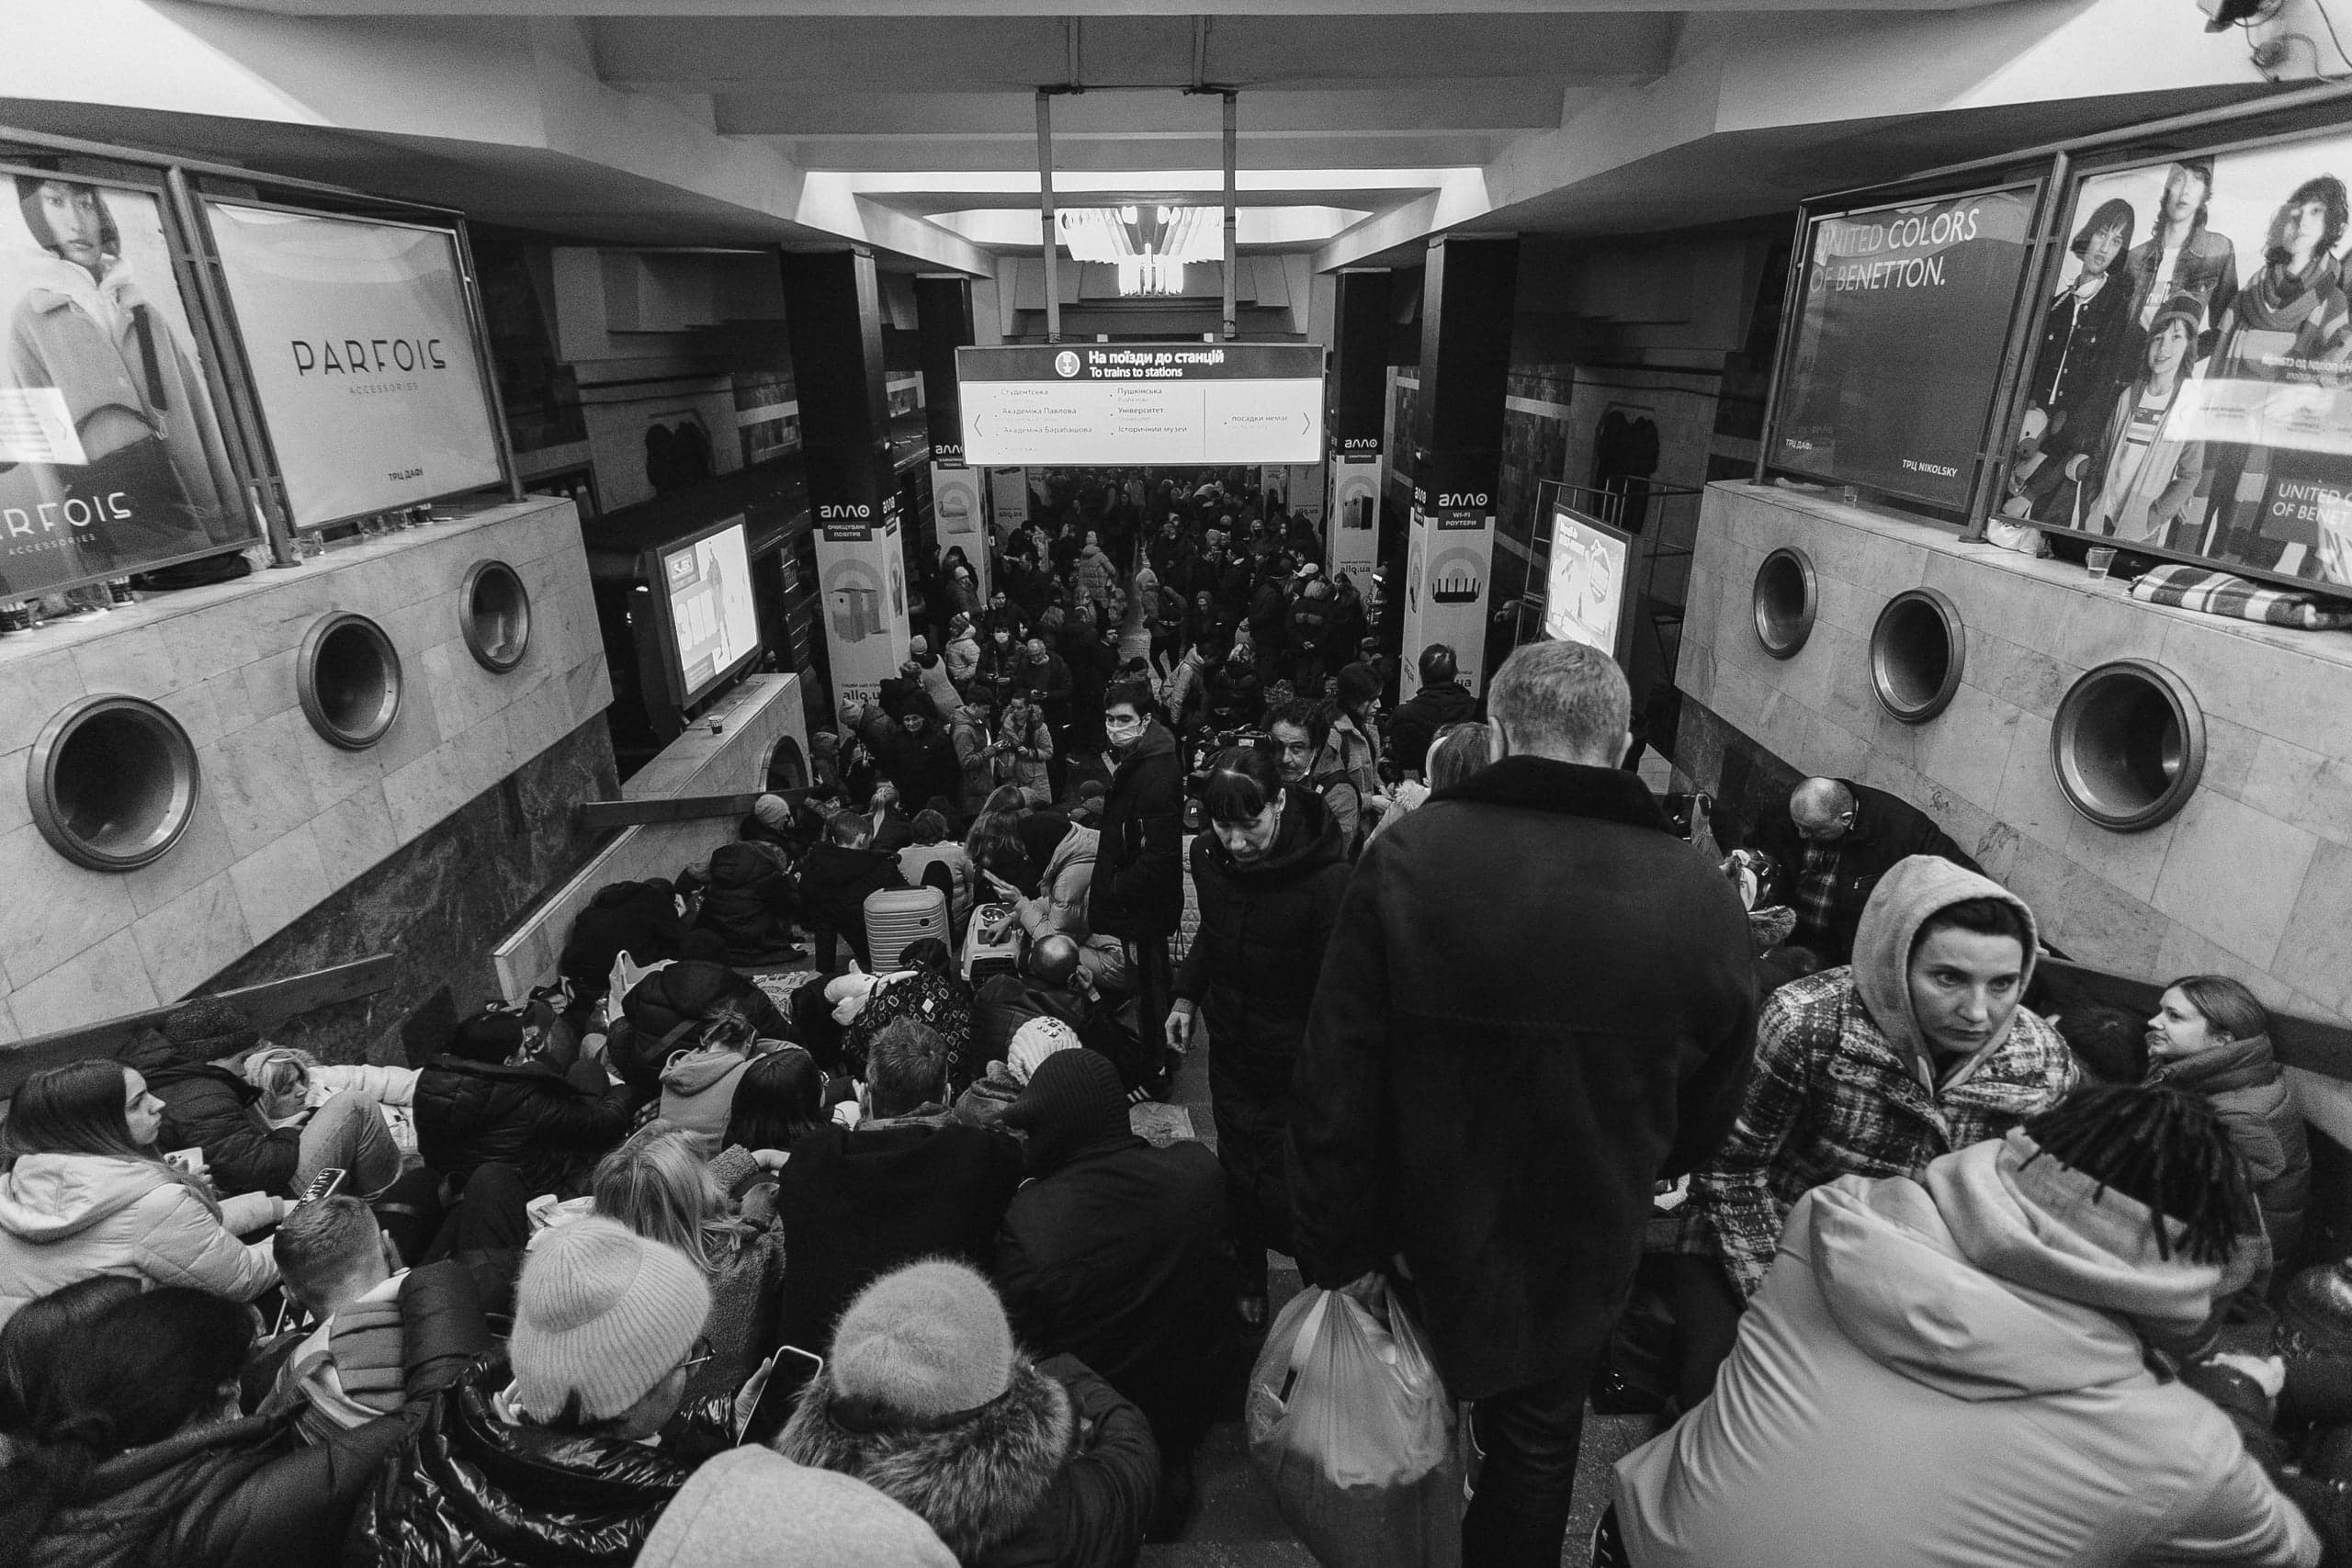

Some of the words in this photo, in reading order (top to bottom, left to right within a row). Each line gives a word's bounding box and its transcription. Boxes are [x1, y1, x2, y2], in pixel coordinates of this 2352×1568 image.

[1888, 208, 1980, 249] COLORS
[1810, 266, 1833, 293] OF
[1836, 255, 1946, 291] BENETTON.
[291, 338, 447, 376] PARFOIS
[1088, 350, 1107, 364] На
[1109, 350, 1153, 366] поїзди
[1154, 353, 1172, 366] до
[1174, 349, 1225, 366] станцій
[1090, 367, 1102, 378] To
[1103, 367, 1131, 378] trains
[1133, 367, 1144, 378] to
[1145, 367, 1183, 378] stations
[349, 382, 419, 395] ACCESSORIES
[935, 445, 963, 455] алл
[1902, 459, 1917, 472] ТРЦ
[1917, 461, 1959, 478] NIKOLSKY
[2278, 483, 2341, 503] UNITED
[0, 491, 131, 540] RFOIS
[2272, 502, 2296, 517] OF
[2297, 504, 2352, 526] BENET
[9, 532, 96, 555] ACCESSORIES
[842, 689, 881, 702] allo.u
